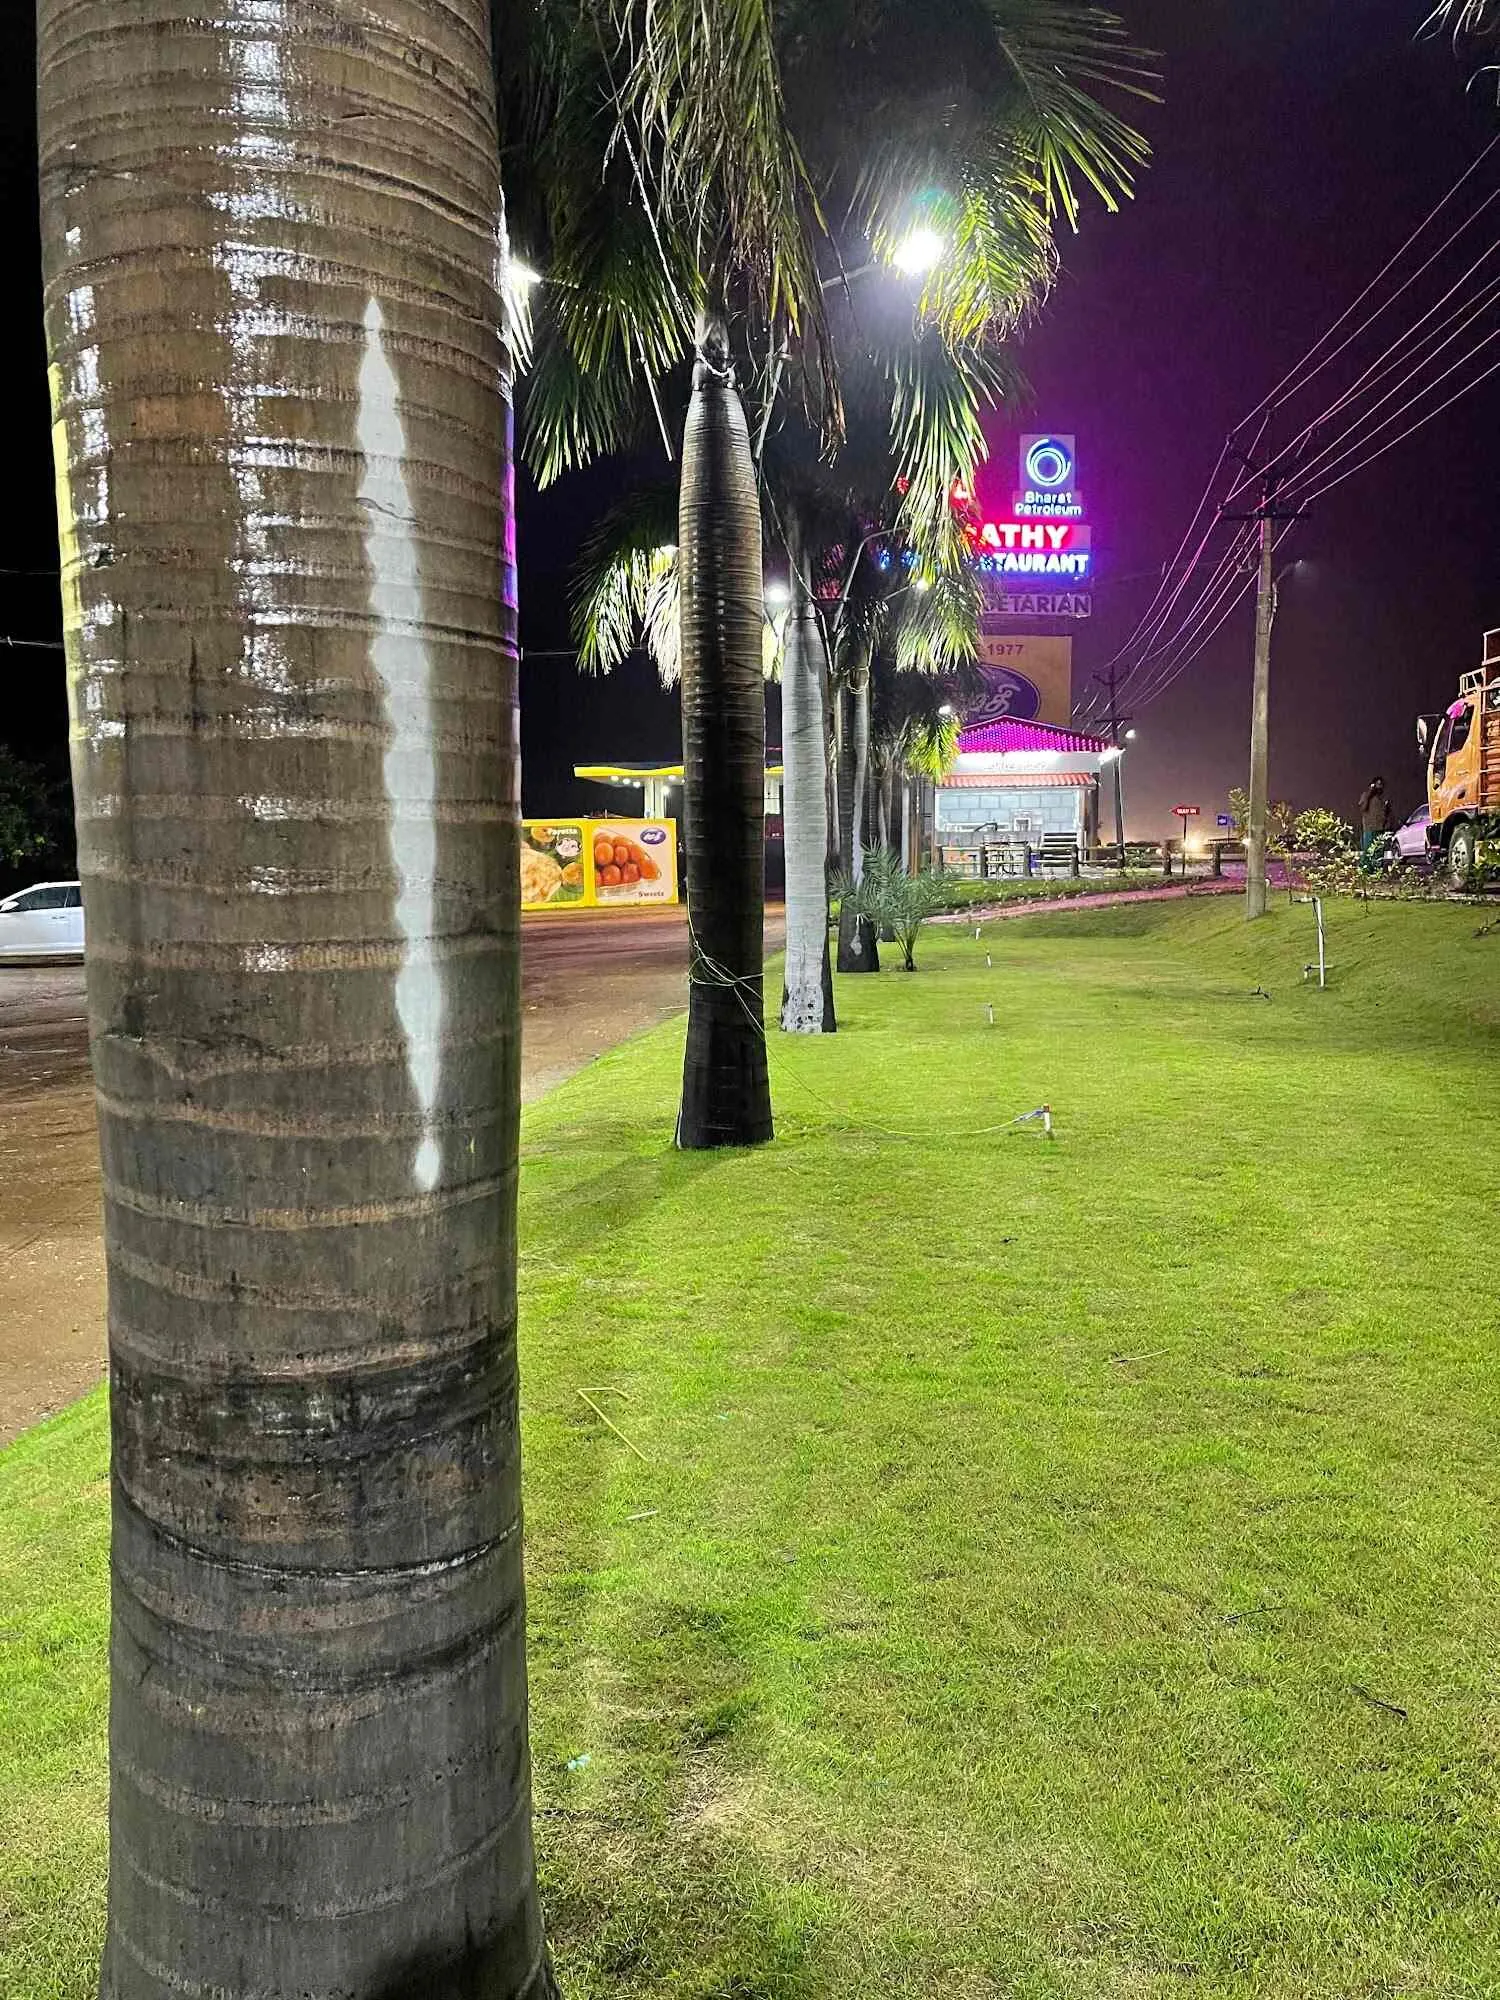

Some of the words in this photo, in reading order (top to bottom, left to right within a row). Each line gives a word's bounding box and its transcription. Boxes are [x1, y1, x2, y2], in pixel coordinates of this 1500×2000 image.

[1025, 491, 1071, 504] Bharat
[1015, 502, 1082, 516] Petroleum
[987, 643, 1024, 656] 1977
